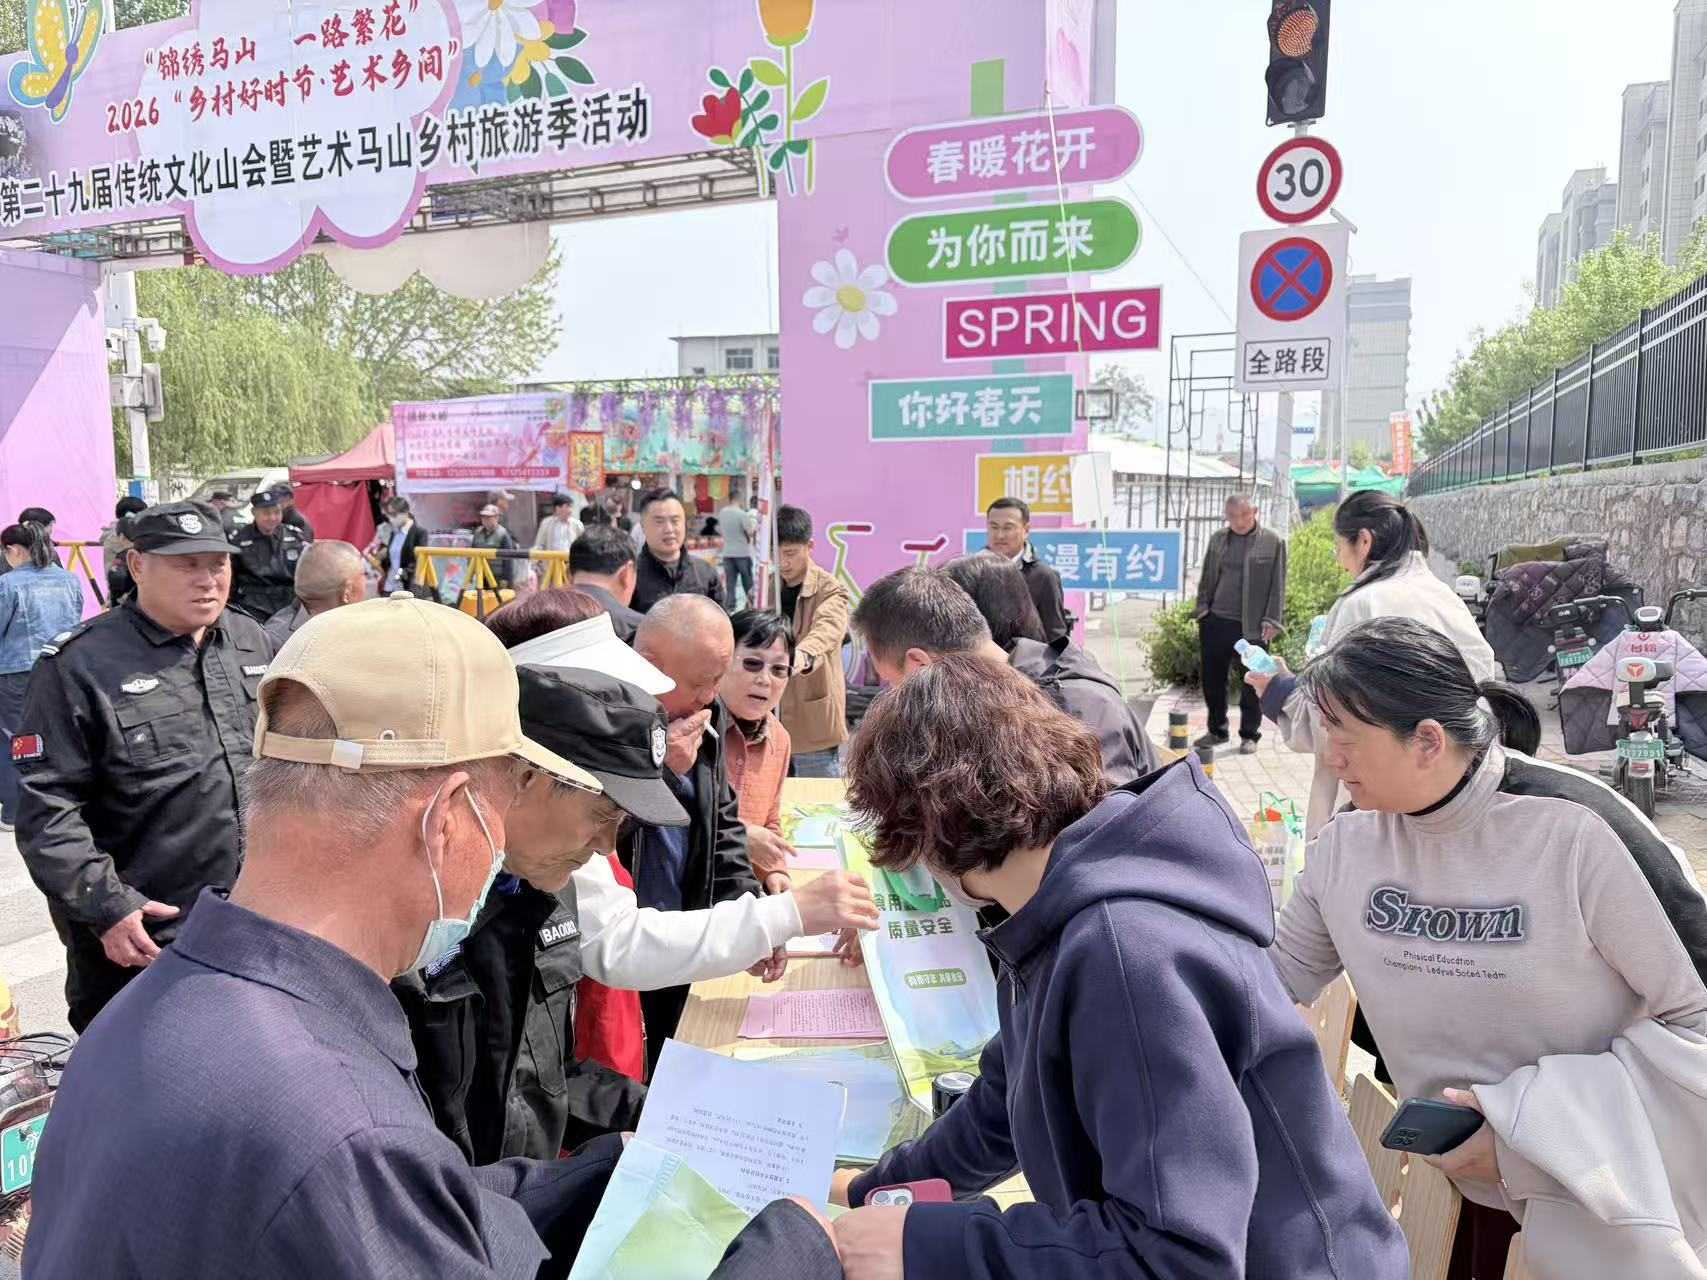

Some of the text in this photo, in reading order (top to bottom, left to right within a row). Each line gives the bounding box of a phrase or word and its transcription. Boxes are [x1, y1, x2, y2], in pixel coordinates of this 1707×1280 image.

[107, 97, 159, 133] 2026
[0, 87, 648, 223] 第二十九届传统文化山会暨艺术马山乡村旅游季活动
[927, 127, 1096, 184] 春暖花开
[1274, 159, 1324, 201] 30
[927, 215, 1094, 269] 为你而来
[957, 299, 1147, 348] SPRING
[1249, 347, 1325, 375] 全路段
[897, 386, 1043, 429] 你好春天
[1034, 543, 1165, 583] 漫有约
[888, 916, 954, 940] 质量安全
